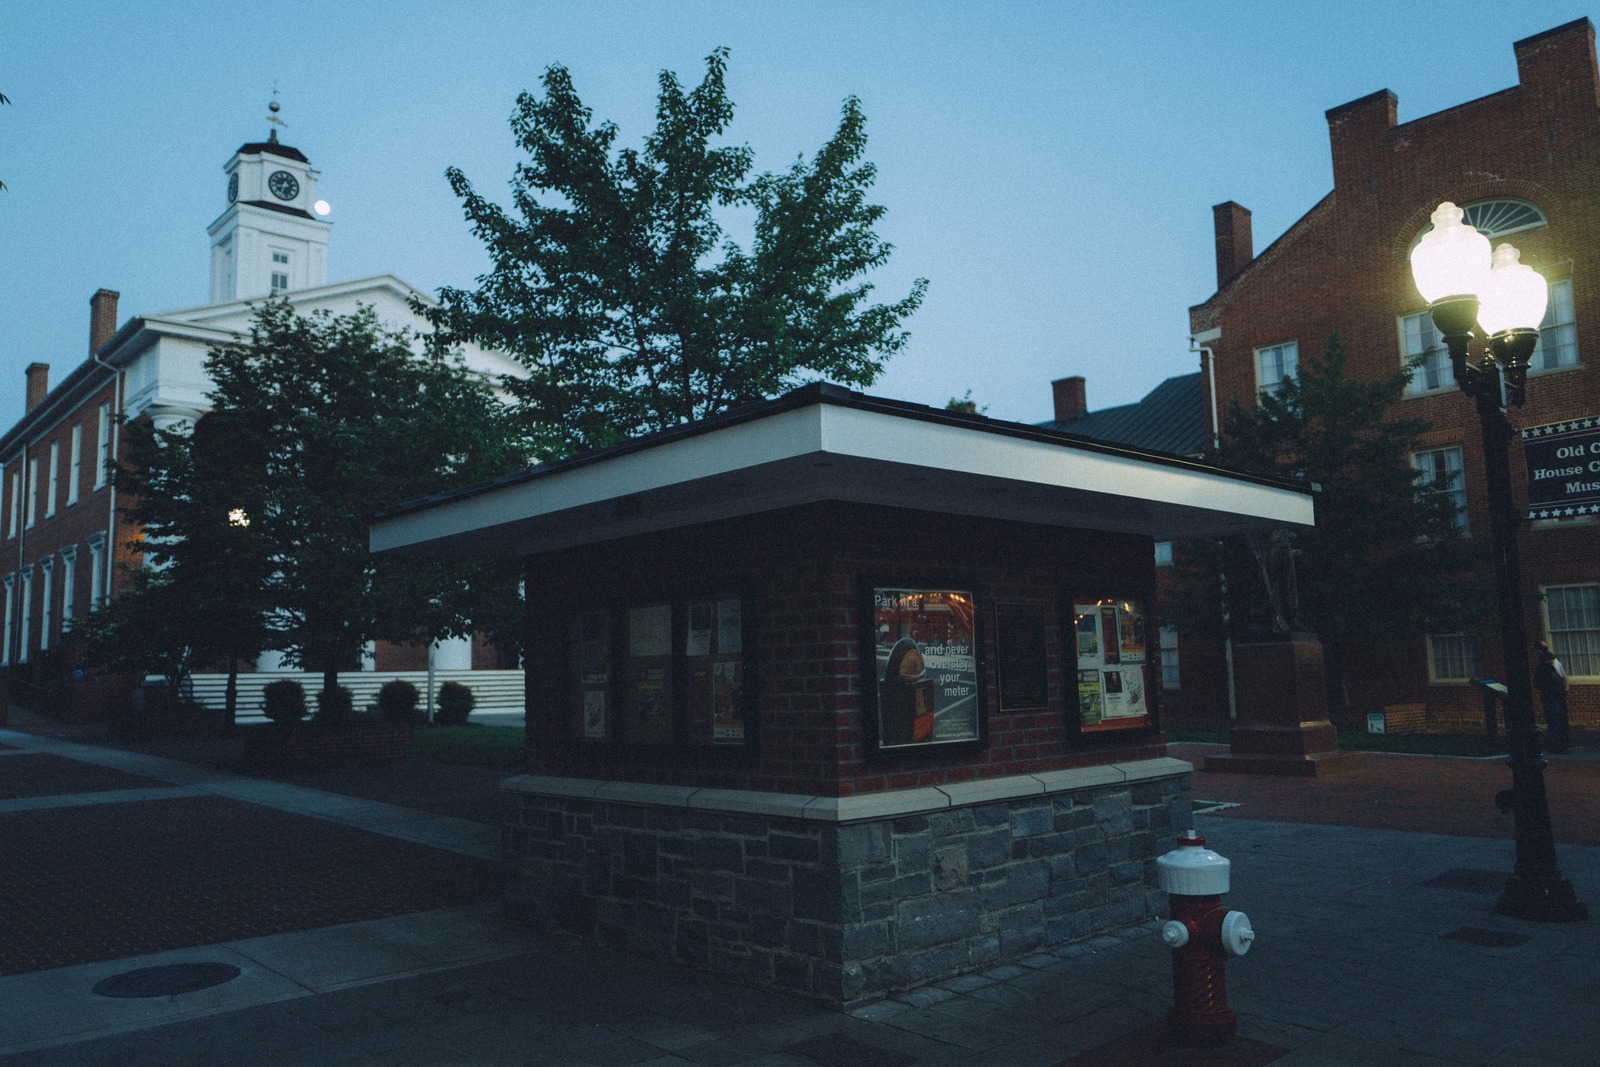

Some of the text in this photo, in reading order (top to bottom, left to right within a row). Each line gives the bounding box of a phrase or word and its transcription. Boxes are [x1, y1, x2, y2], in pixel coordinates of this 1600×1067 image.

[1556, 445, 1585, 459] Old
[1534, 466, 1583, 480] House
[874, 594, 917, 607] Park in a
[924, 644, 969, 656] and never
[930, 659, 969, 670] overstay
[939, 673, 960, 686] your
[944, 687, 970, 697] meter
